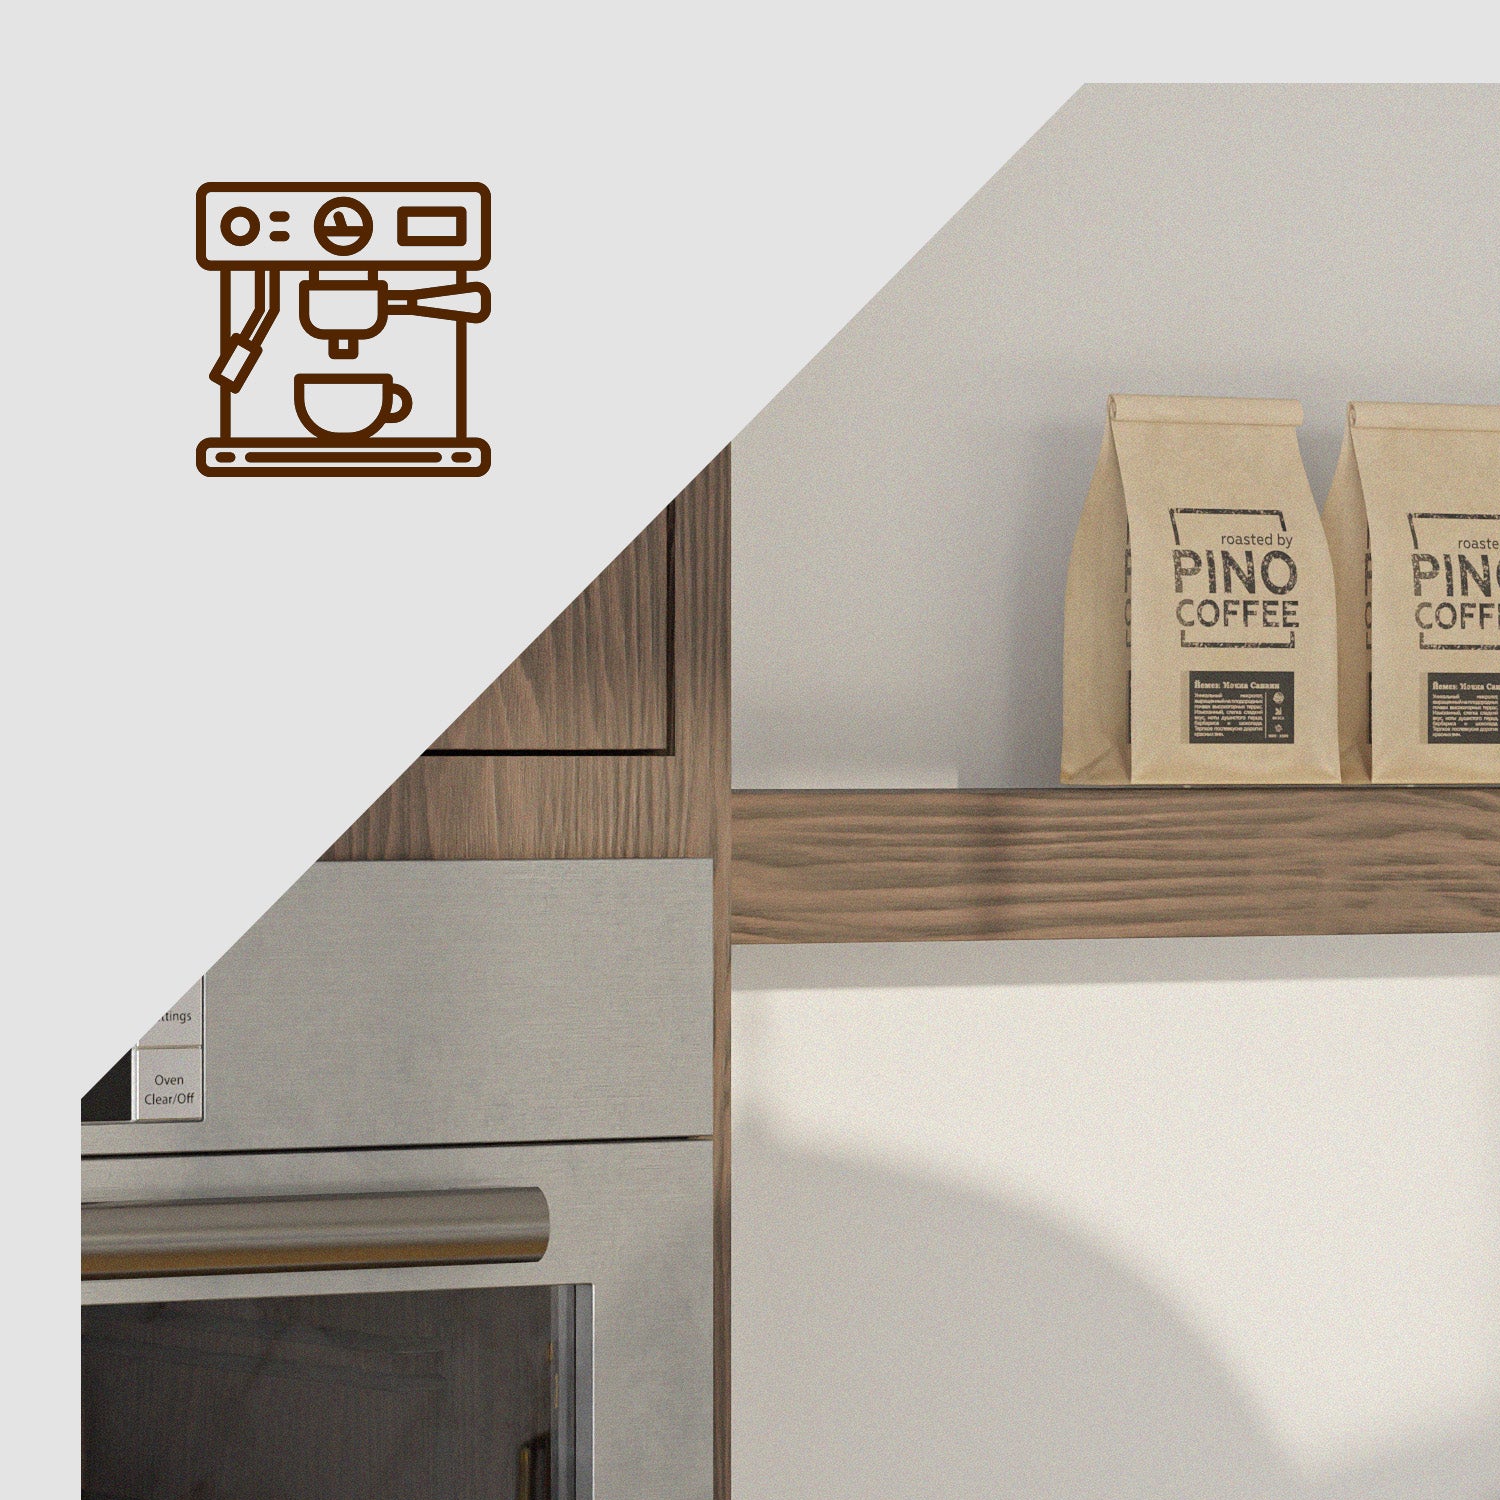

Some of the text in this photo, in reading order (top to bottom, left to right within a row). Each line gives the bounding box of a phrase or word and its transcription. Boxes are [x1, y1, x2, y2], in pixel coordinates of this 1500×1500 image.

[1221, 533, 1293, 548] roasted by
[1172, 549, 1298, 595] PINO
[1176, 599, 1300, 627] COFFEE
[155, 1074, 184, 1086] Oven
[144, 1092, 195, 1105] Clear/Off
